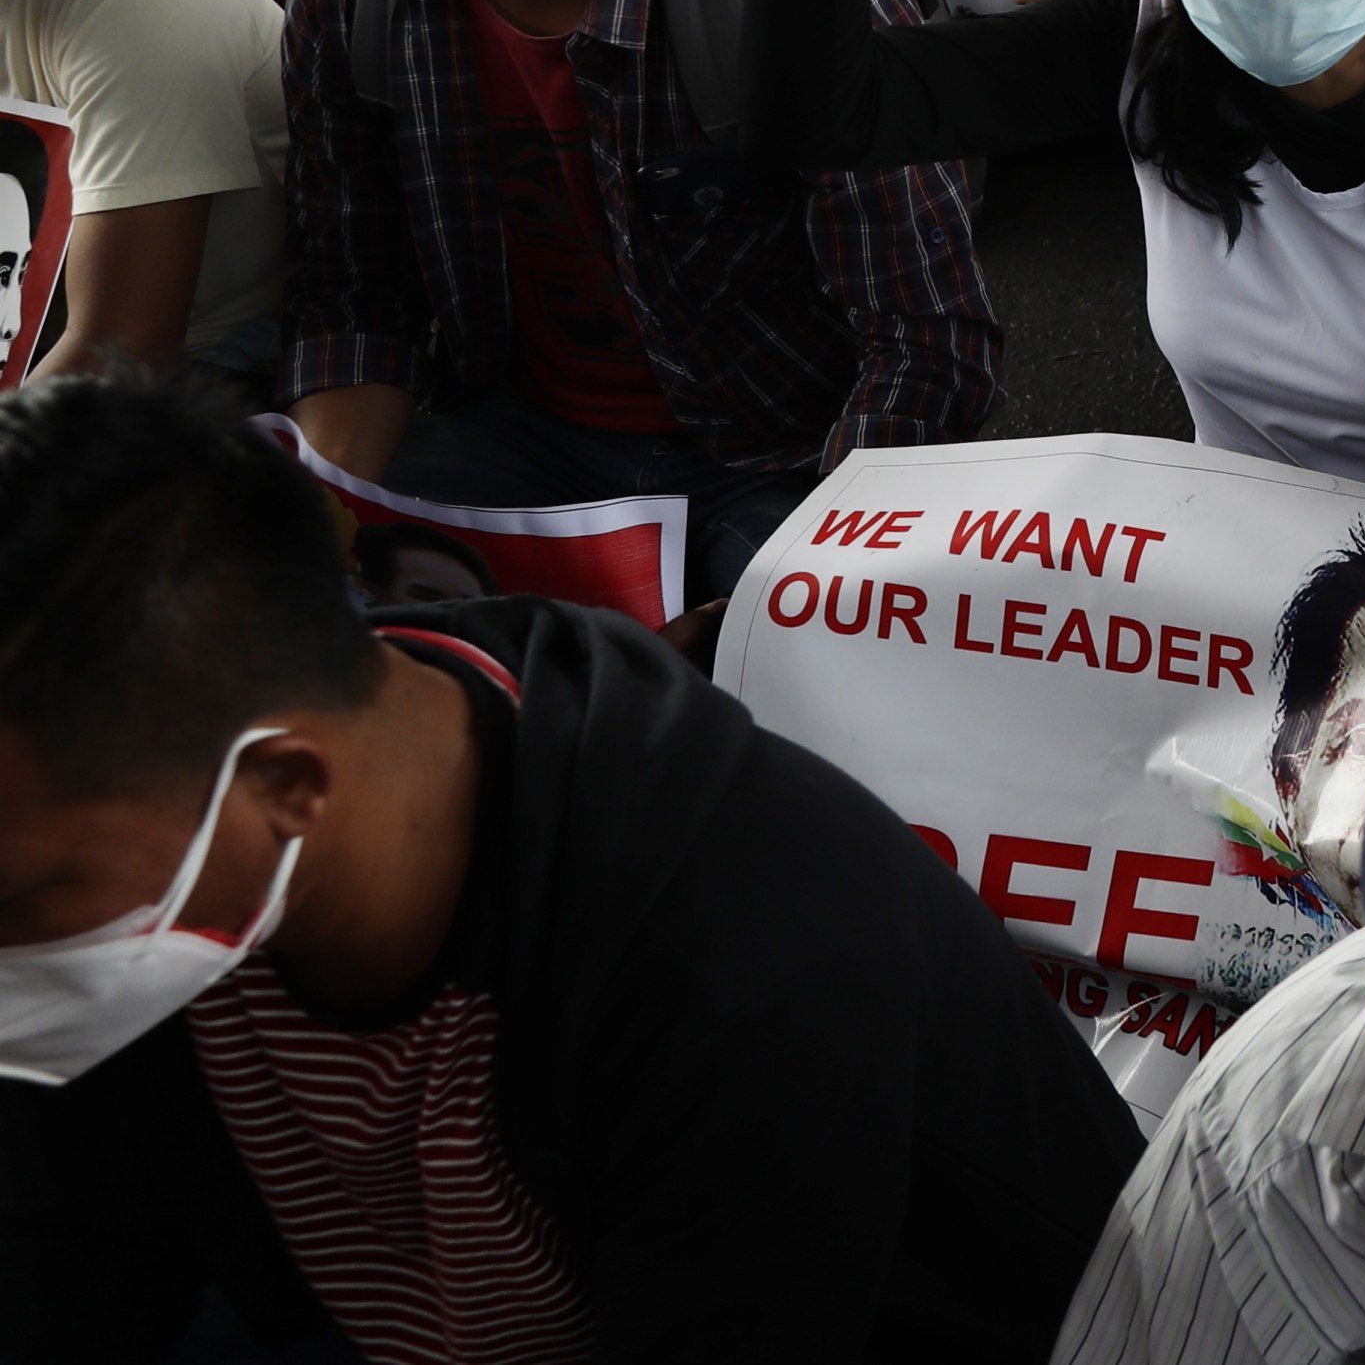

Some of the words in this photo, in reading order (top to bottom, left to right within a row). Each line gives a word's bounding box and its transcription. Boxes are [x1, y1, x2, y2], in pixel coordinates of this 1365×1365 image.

[811, 509, 924, 550] WE
[949, 509, 1167, 584] WANT
[766, 571, 930, 646] OUR
[953, 592, 1256, 696] LEADER
[1120, 979, 1235, 1061] SAN
